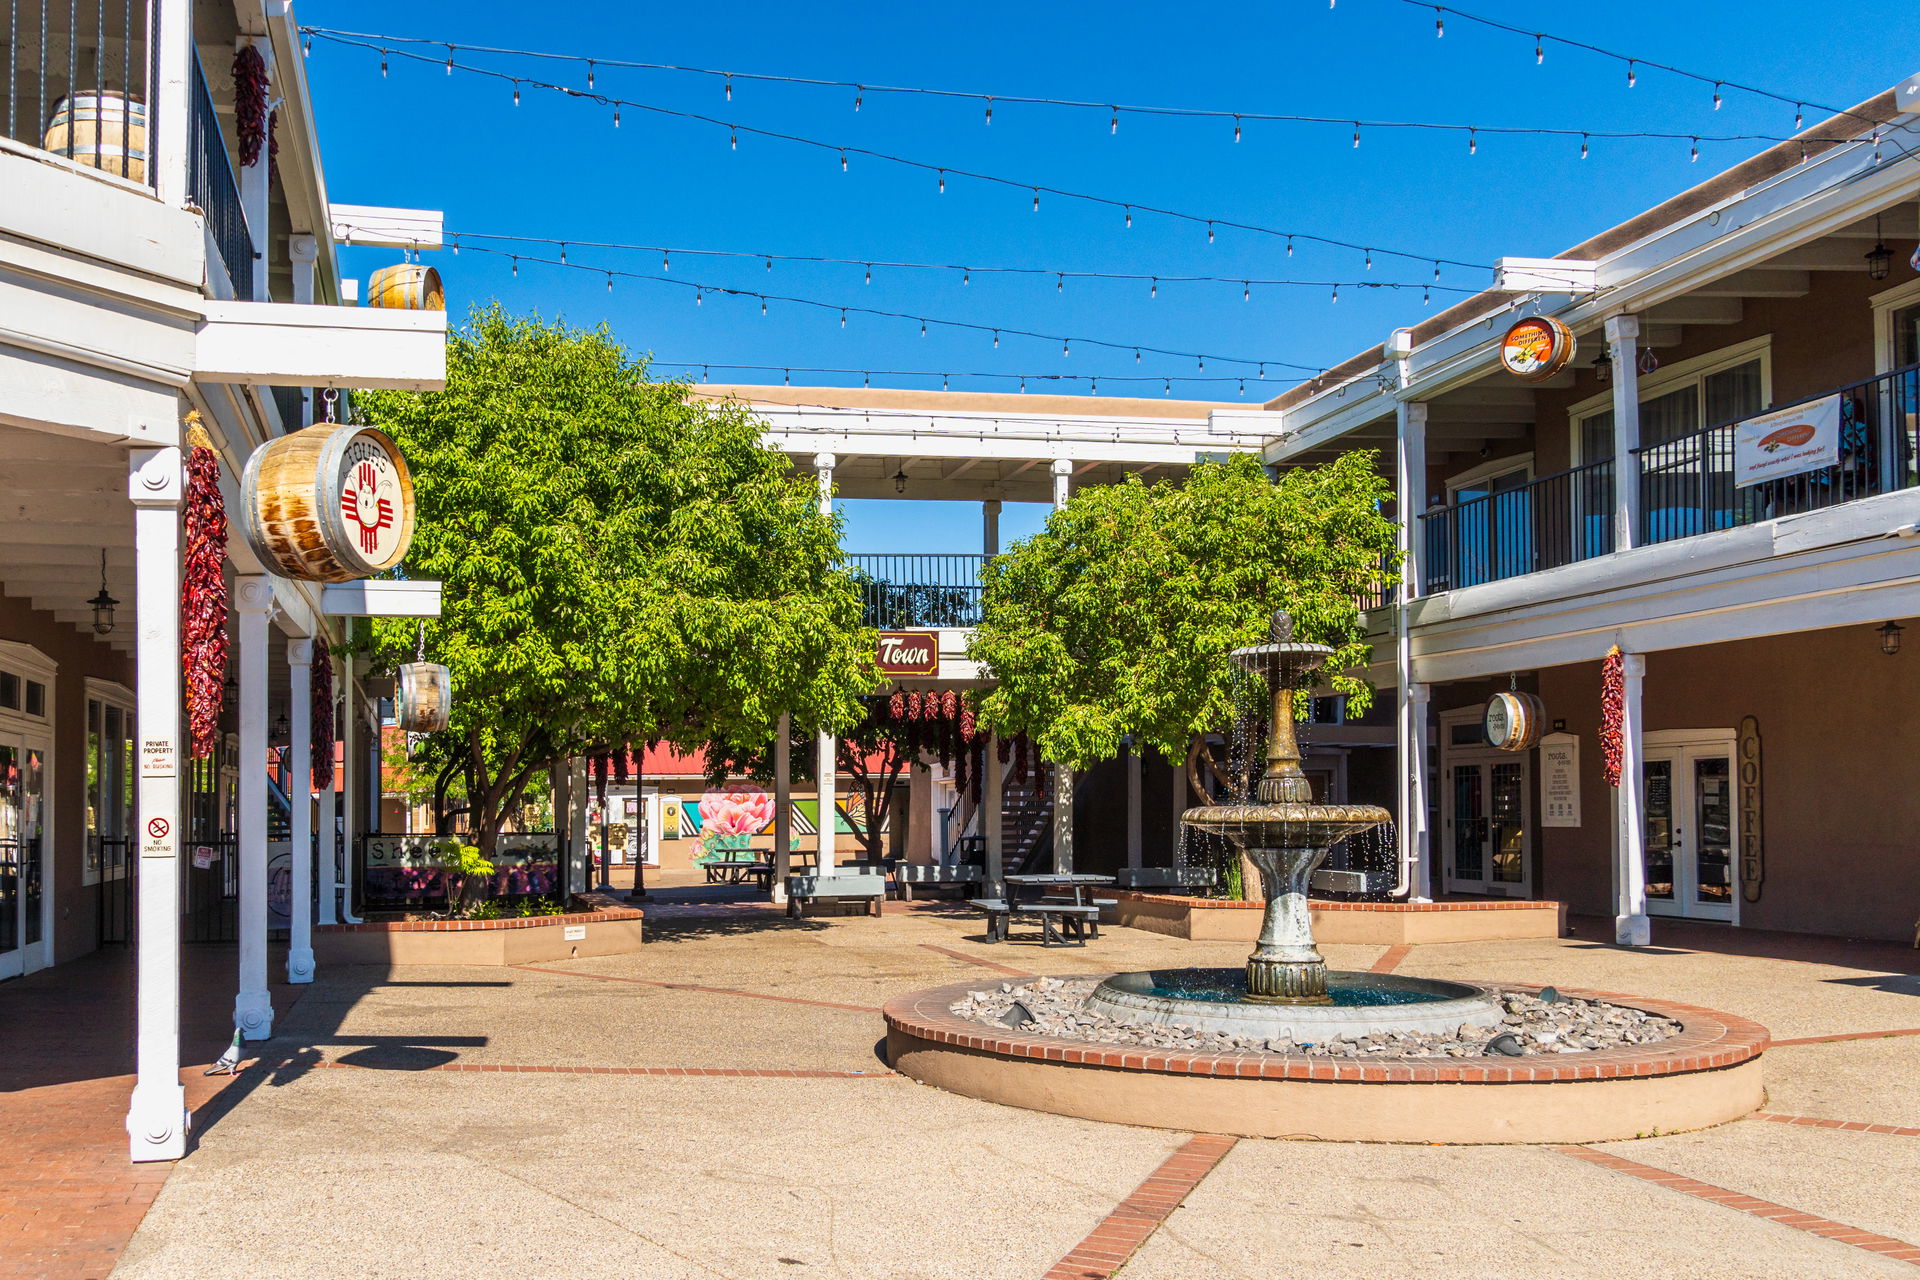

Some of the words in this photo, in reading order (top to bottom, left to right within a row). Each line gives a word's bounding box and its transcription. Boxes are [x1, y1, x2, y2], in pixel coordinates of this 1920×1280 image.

[1511, 330, 1548, 342] SOMETHING
[1518, 336, 1550, 346] DIFFERENT
[343, 441, 388, 474] TOURS
[1802, 449, 1817, 457] looking
[880, 637, 930, 665] Town
[1742, 736, 1758, 881] COFFEE
[371, 841, 499, 860] Shee
